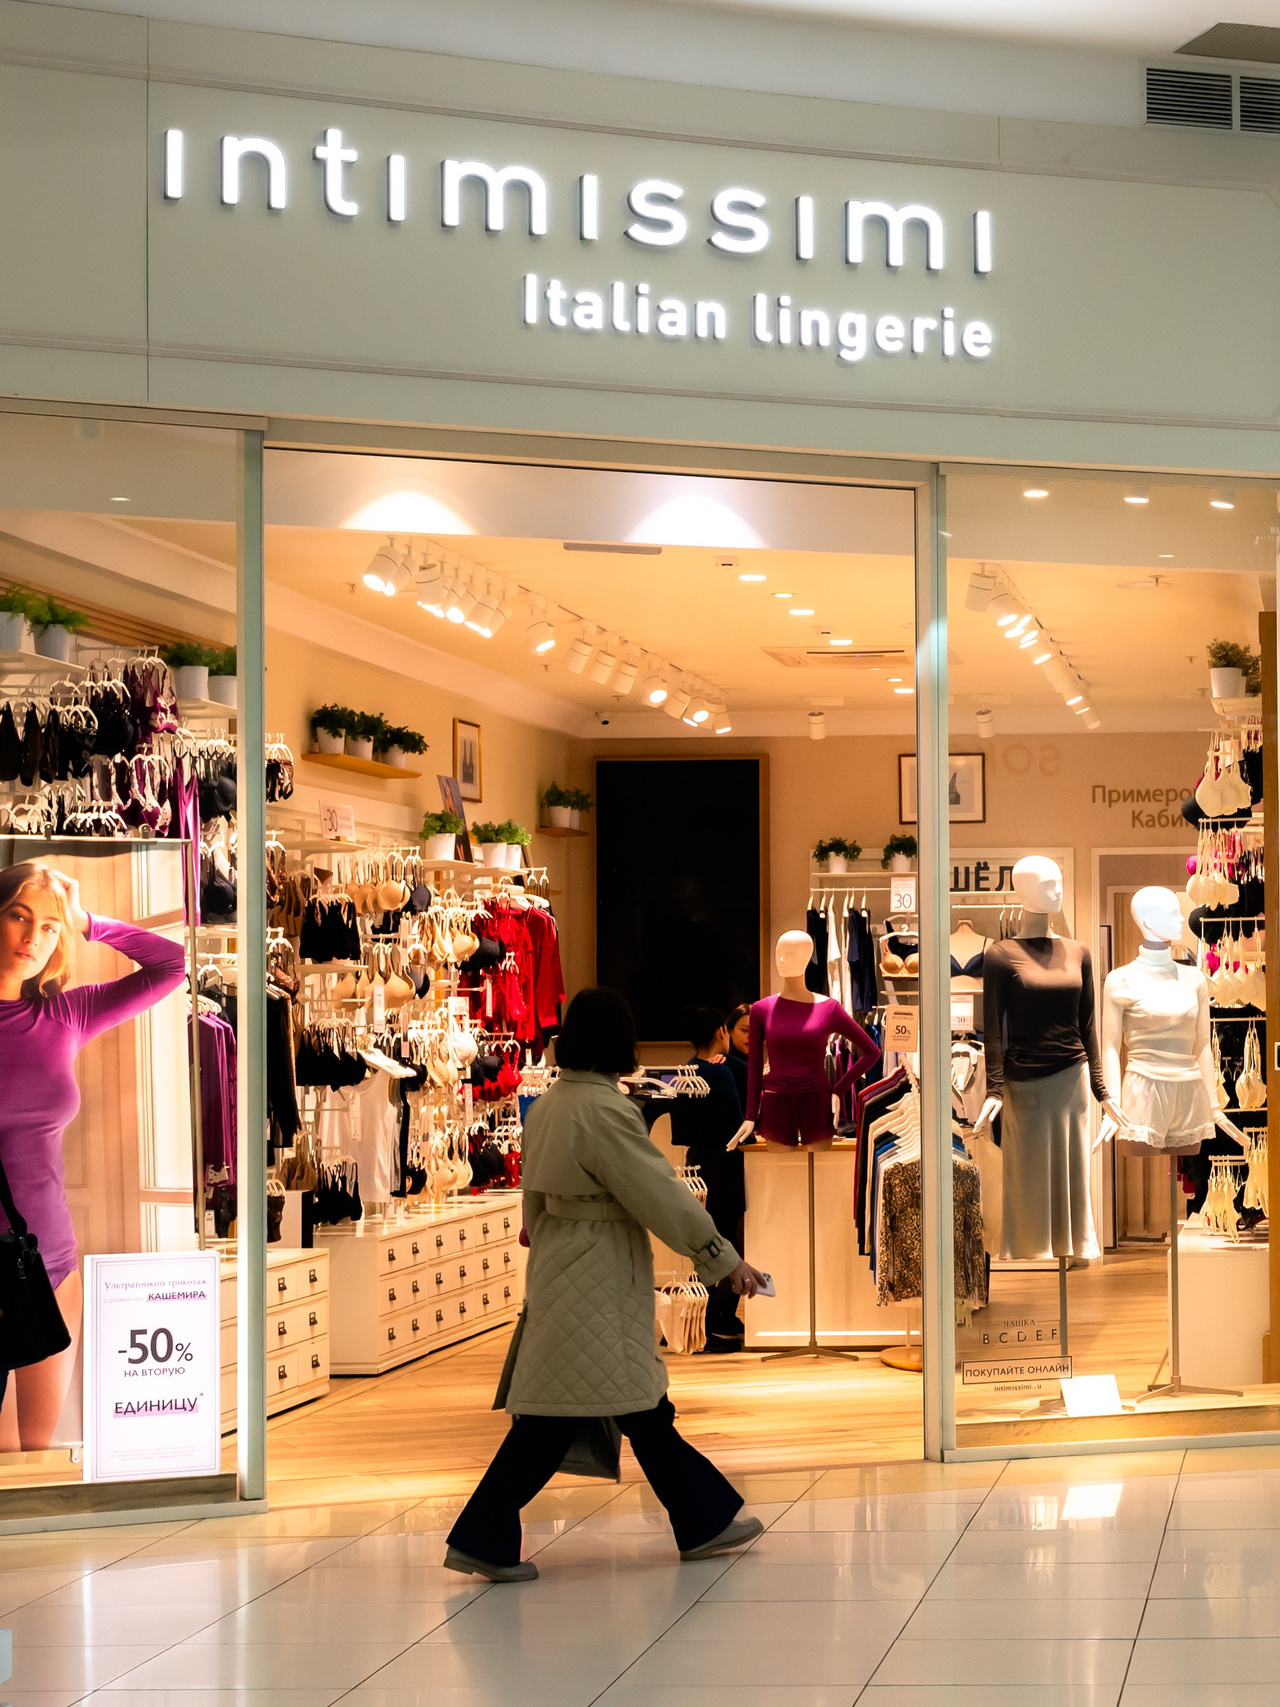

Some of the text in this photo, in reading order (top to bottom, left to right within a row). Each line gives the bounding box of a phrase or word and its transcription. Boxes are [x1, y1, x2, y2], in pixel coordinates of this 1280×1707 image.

[164, 127, 993, 274] intimissimi
[522, 274, 994, 364] Italian lingerie
[1092, 785, 1197, 808] Примеро
[950, 861, 1016, 892] ШЁЛ
[148, 1290, 206, 1301] КАШЕМИРА
[118, 1327, 193, 1364] -50%
[124, 1367, 186, 1378] НА ВТОРУЮ
[965, 1362, 1069, 1378] ПОКУПАЙТЕ ОНЛАЙН
